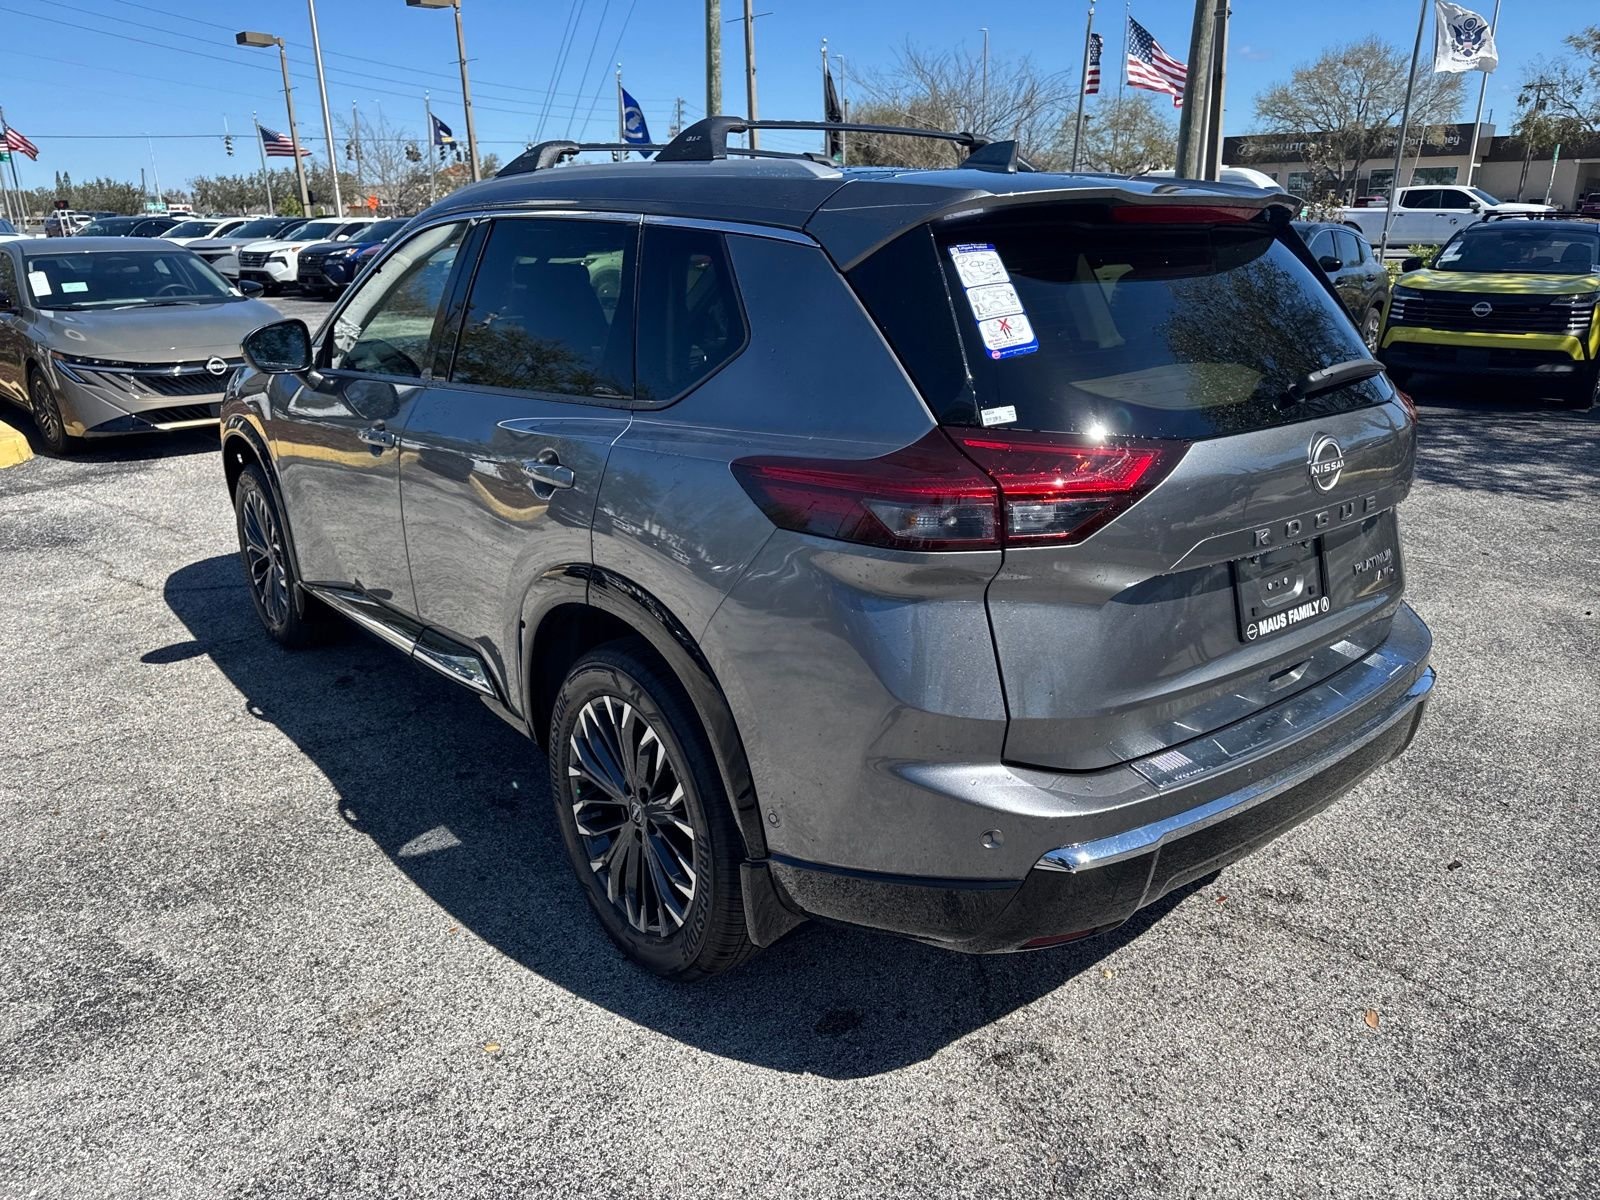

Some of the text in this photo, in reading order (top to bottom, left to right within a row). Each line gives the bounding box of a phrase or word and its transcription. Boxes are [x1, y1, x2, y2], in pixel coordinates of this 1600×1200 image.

[1311, 459, 1345, 475] NISSAN
[1254, 495, 1376, 547] ROGUE
[1353, 548, 1393, 576] PLATINUM
[1258, 599, 1320, 636] MAUS FAMILY
[680, 834, 710, 961] BRIDGESTONE
